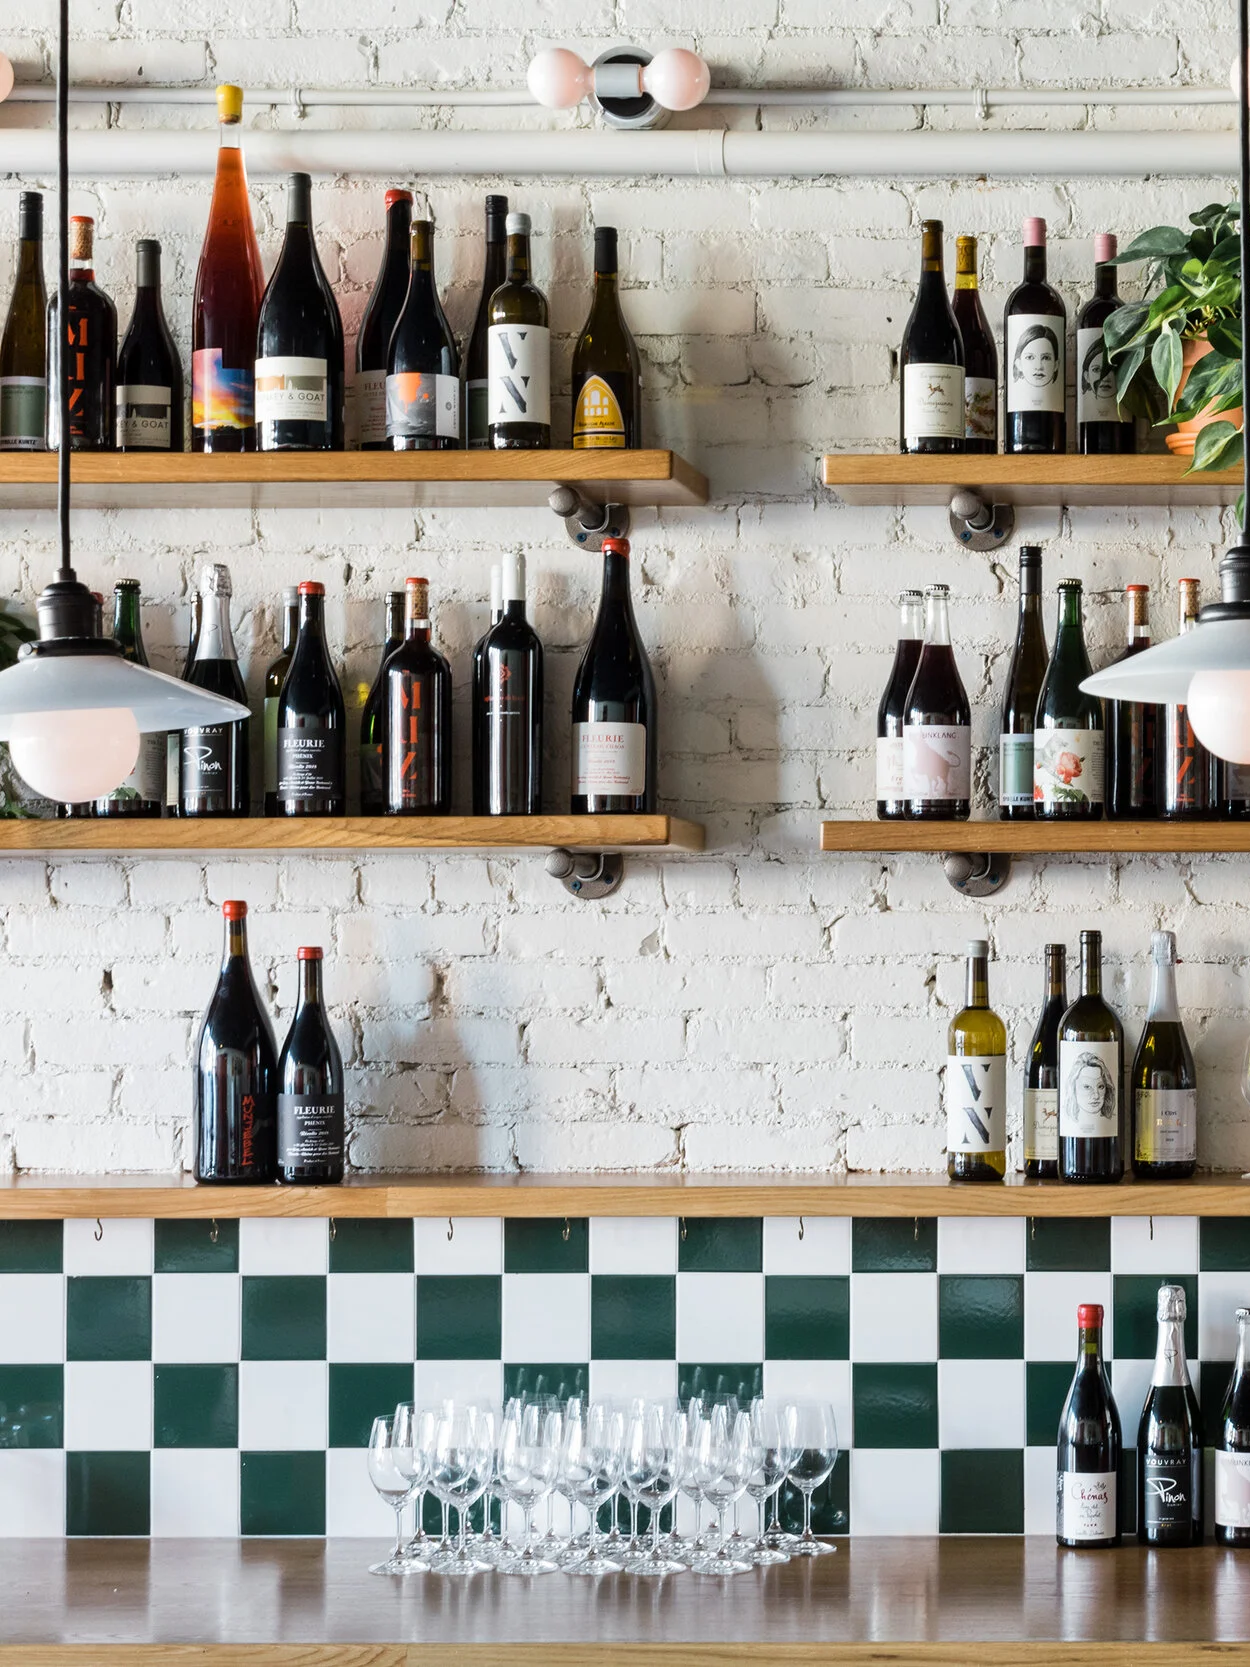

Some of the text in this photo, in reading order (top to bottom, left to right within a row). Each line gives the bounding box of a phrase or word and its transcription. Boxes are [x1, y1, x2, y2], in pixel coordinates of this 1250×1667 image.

[288, 392, 294, 400] &
[298, 392, 325, 401] GOAT
[141, 420, 169, 428] GOAT
[184, 727, 223, 735] VOUVRAY
[283, 739, 325, 748] FLEURIE
[294, 1106, 335, 1115] FLEURIE
[1146, 1477, 1186, 1503] Pinon
